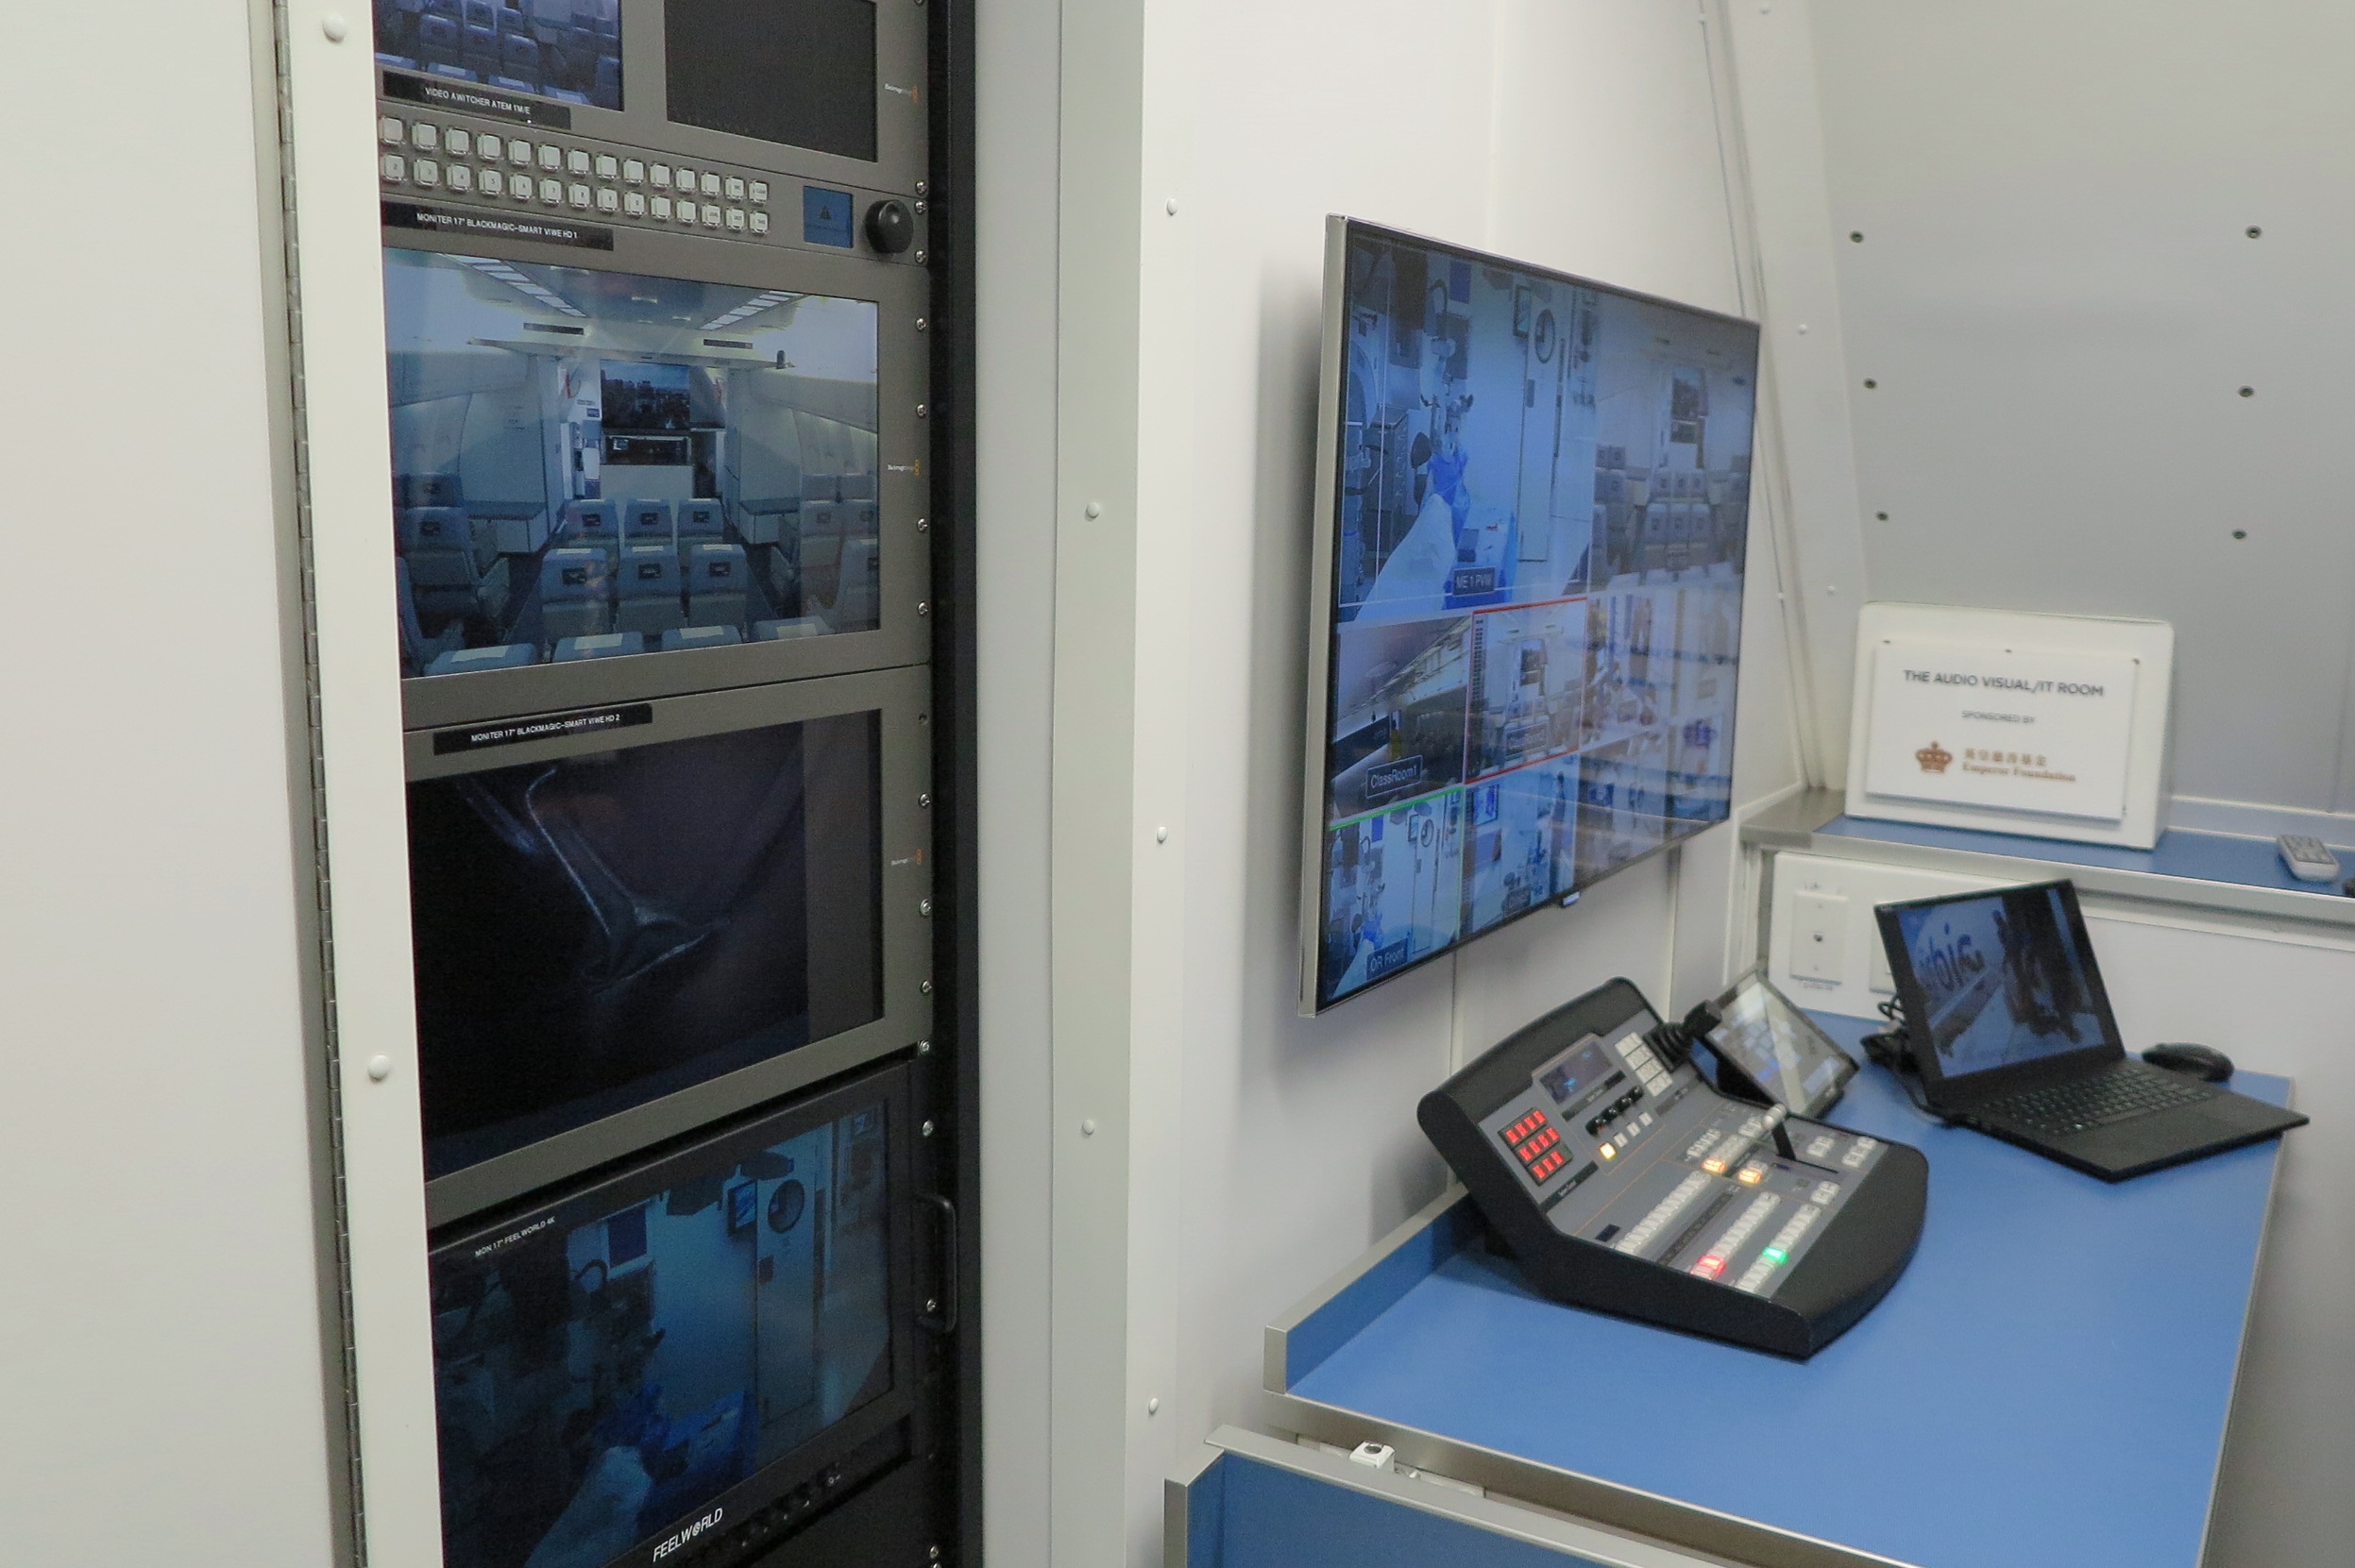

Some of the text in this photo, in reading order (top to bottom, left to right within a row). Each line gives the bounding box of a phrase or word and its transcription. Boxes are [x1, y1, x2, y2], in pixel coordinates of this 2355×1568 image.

[425, 87, 449, 99] VIDEO
[491, 100, 512, 111] ATEM
[416, 212, 452, 225] MONITER
[1903, 669, 1930, 683] THE
[1933, 672, 1978, 686] AUDIO
[2058, 682, 2104, 696] ROOM
[471, 731, 504, 742] MONITER
[605, 714, 616, 722] HD
[616, 713, 620, 721] 2
[2022, 715, 2036, 724] BY
[475, 1245, 492, 1257] MON
